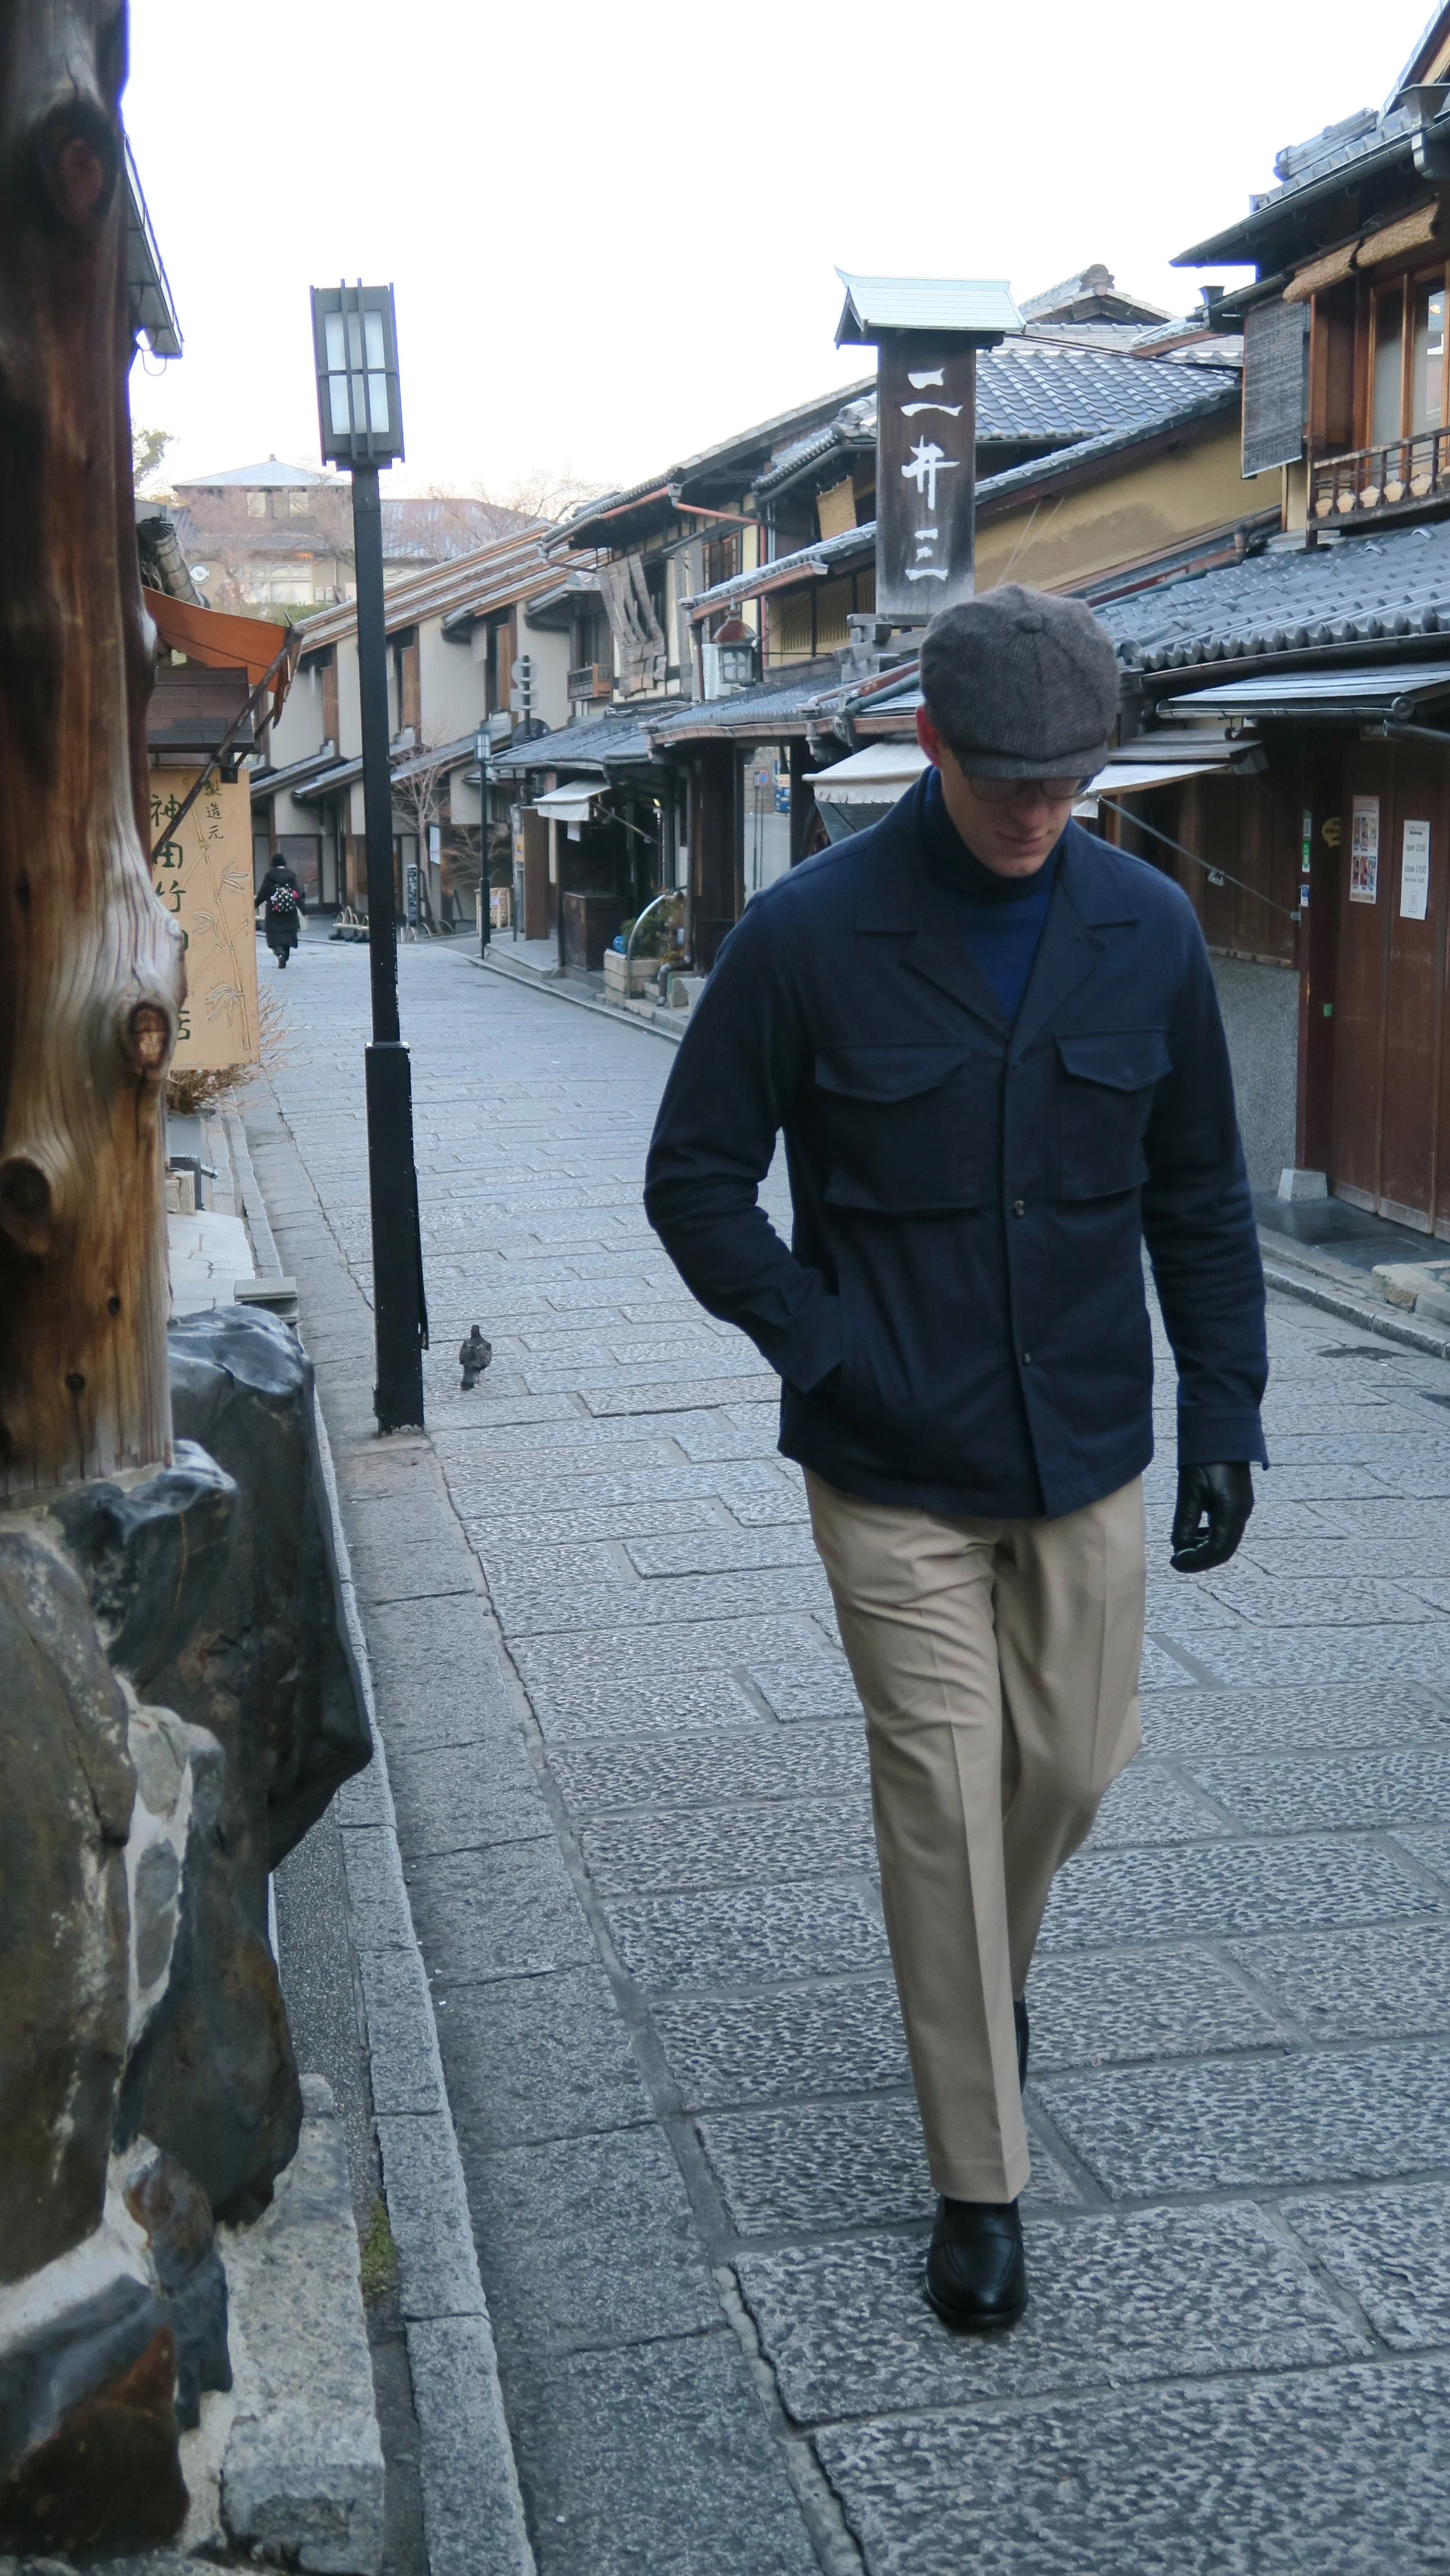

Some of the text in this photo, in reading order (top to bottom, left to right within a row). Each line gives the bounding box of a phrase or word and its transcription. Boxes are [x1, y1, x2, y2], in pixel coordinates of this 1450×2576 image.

[900, 367, 963, 582] 二井三
[204, 779, 224, 840] 製造元
